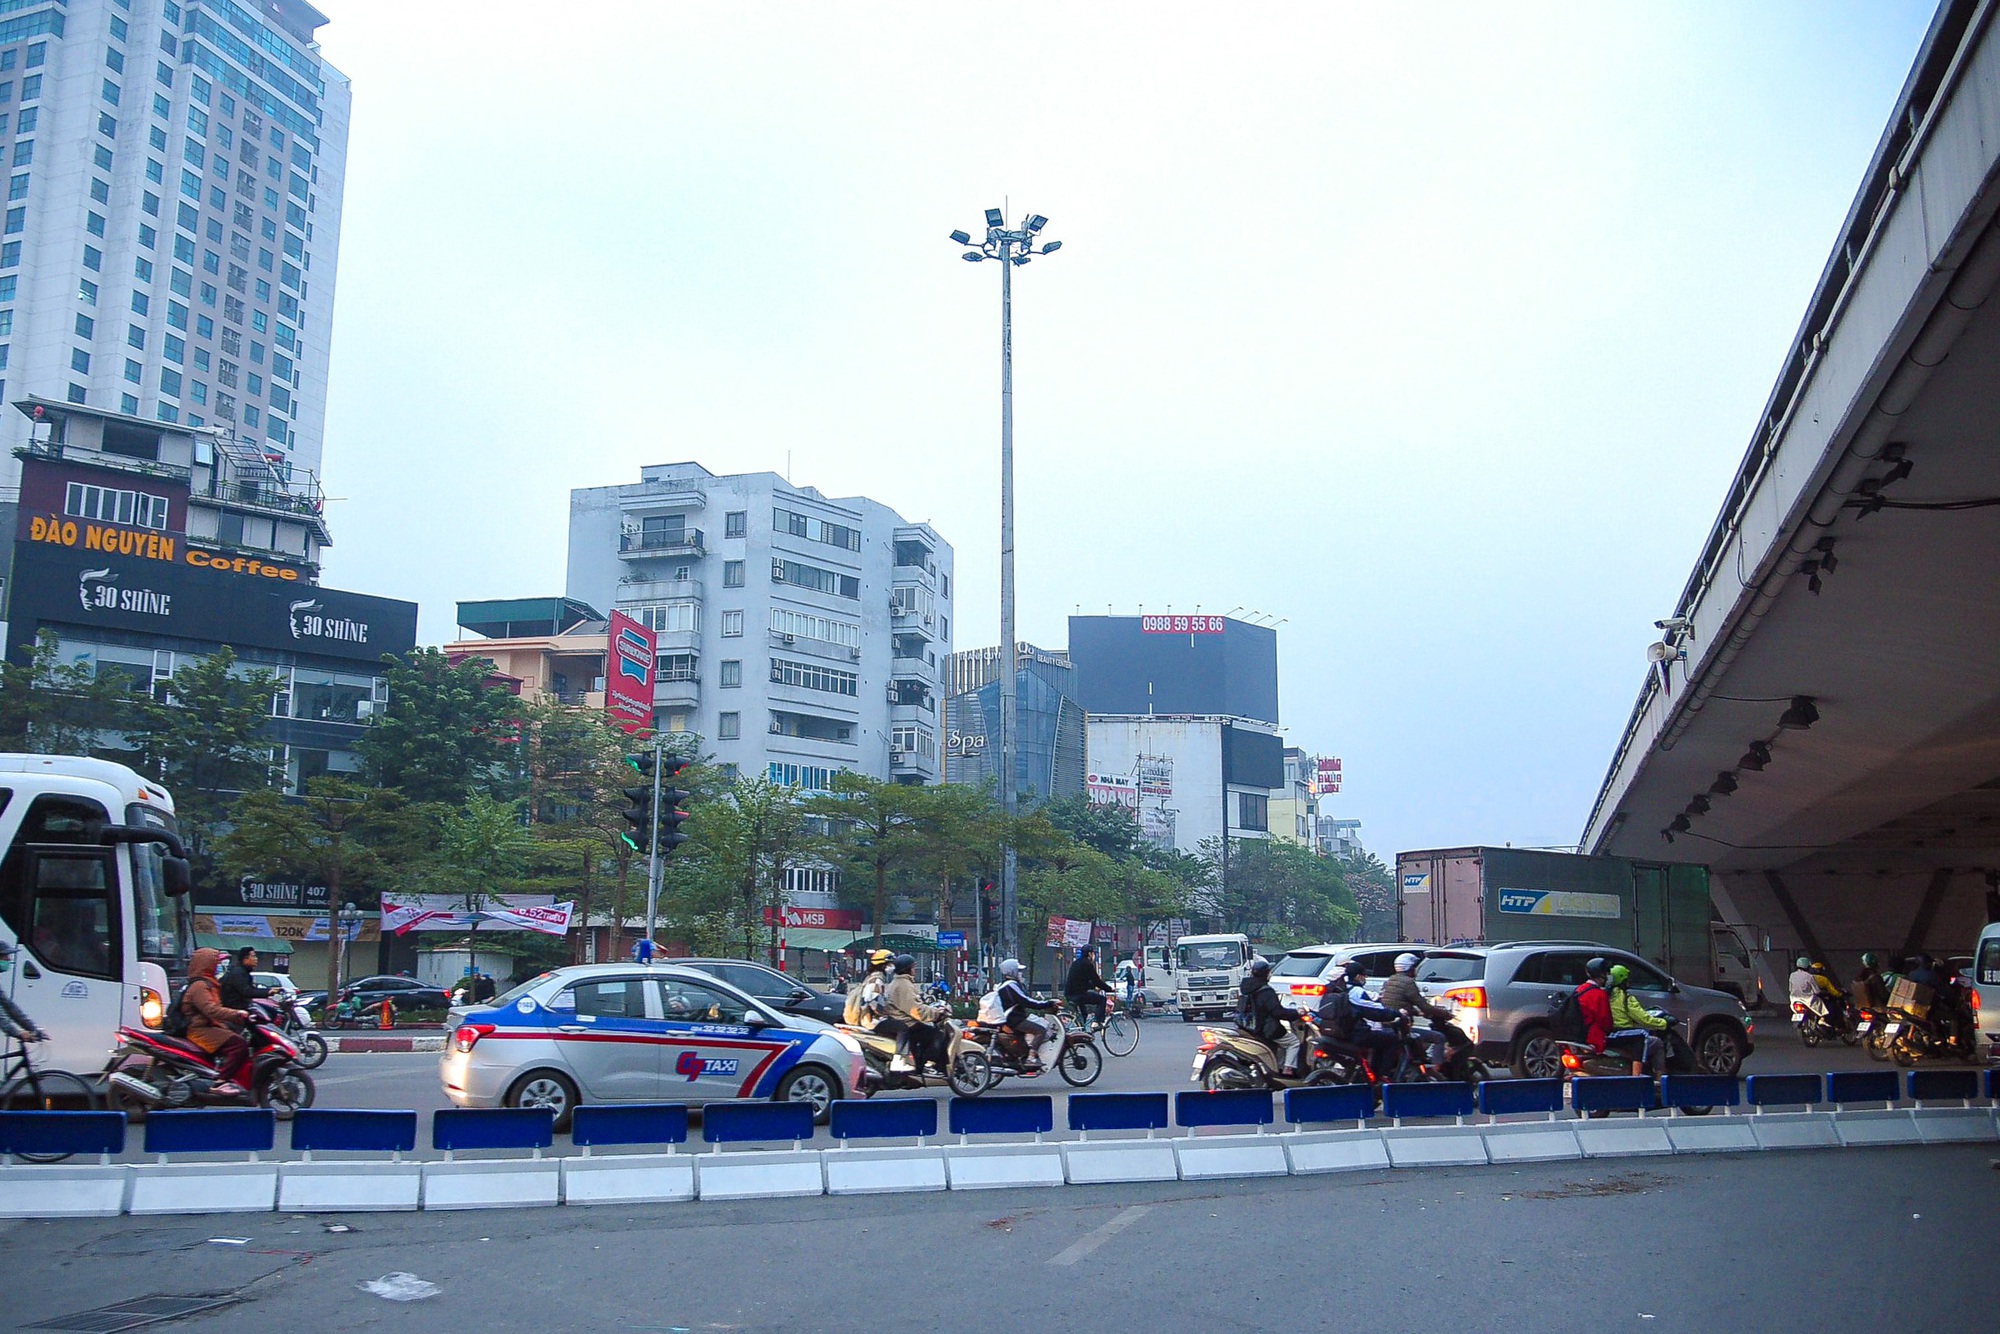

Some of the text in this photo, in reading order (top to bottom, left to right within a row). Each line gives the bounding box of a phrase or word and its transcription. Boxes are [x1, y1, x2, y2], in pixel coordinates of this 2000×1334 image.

[30, 513, 175, 562] ĐÀO NGUYÊN
[186, 550, 298, 581] Coffee
[94, 585, 116, 609] 30
[302, 615, 323, 636] 30
[1142, 616, 1223, 631] 0988 59 55 66
[1037, 653, 1055, 665] BEAUTY
[947, 728, 985, 755] Spa
[1404, 876, 1422, 884] HTP
[250, 883, 264, 899] 30
[306, 887, 326, 897] 407
[1501, 895, 1537, 908] HTP
[803, 913, 825, 925] MSB
[275, 926, 304, 937] 120K
[704, 1060, 738, 1071] TAXI
